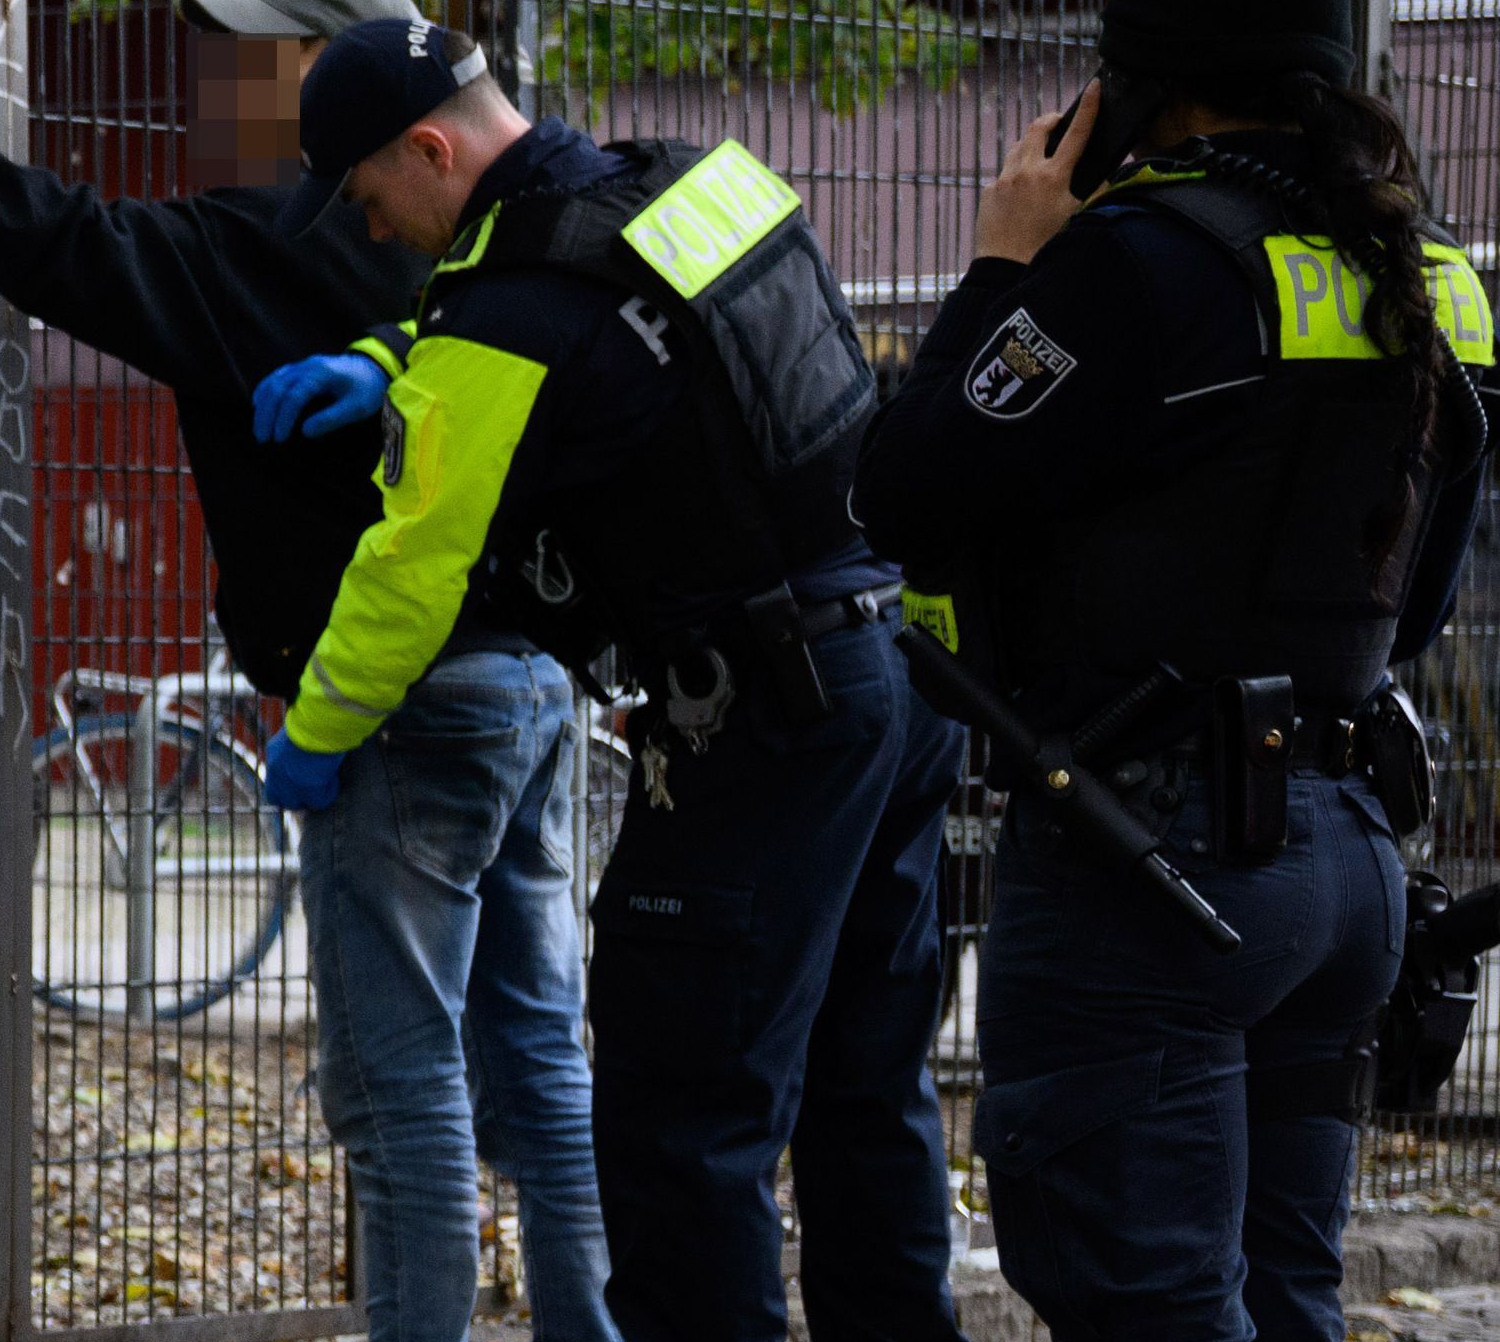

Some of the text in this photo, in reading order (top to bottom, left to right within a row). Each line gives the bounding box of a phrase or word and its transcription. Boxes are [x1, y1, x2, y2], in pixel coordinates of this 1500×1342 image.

[633, 148, 789, 289] POLIZEI
[1283, 253, 1487, 343] POEI
[1008, 314, 1069, 375] POLIZEI
[628, 895, 683, 915] POLIZEI
